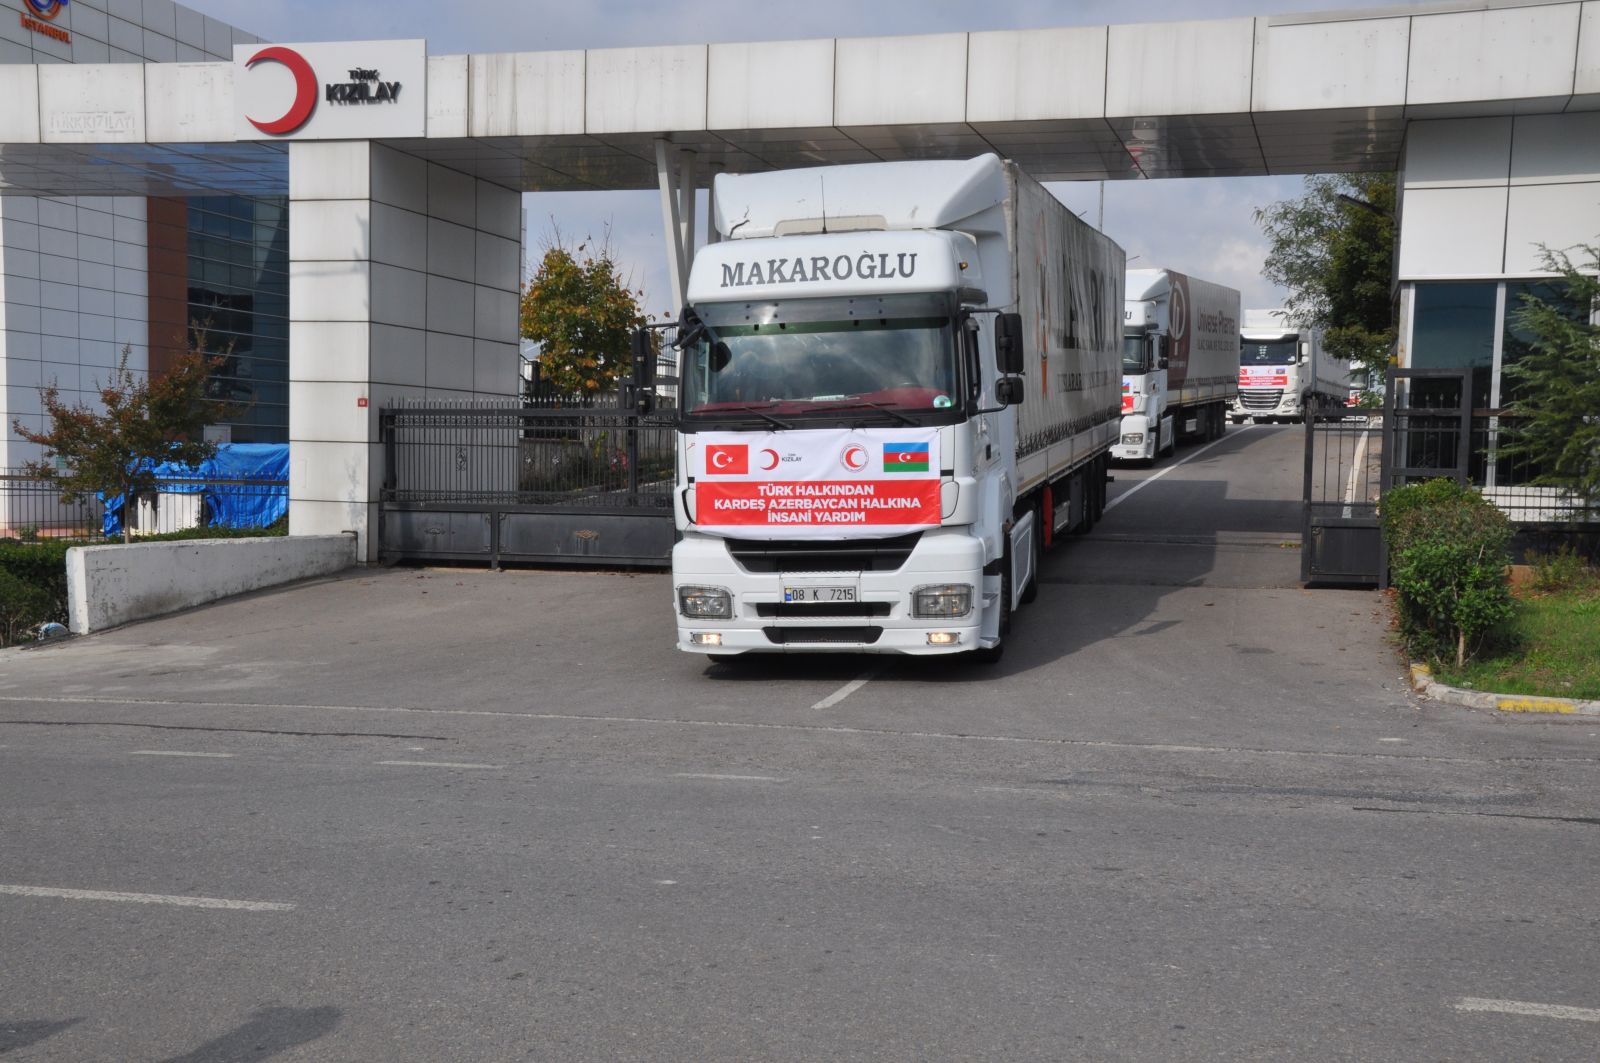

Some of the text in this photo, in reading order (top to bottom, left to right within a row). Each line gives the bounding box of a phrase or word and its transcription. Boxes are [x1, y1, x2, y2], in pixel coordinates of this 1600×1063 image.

[347, 67, 379, 81] TÜRK
[326, 82, 401, 104] KIZILAY
[758, 483, 874, 496] TÜRK HALKINDAN
[714, 497, 921, 511] KARDEŞ AZERBAYCAN HALKINA
[767, 510, 865, 523] İNSANİ YARDIM
[792, 589, 805, 601] 08
[813, 589, 819, 601] K
[830, 588, 853, 601] 7215
